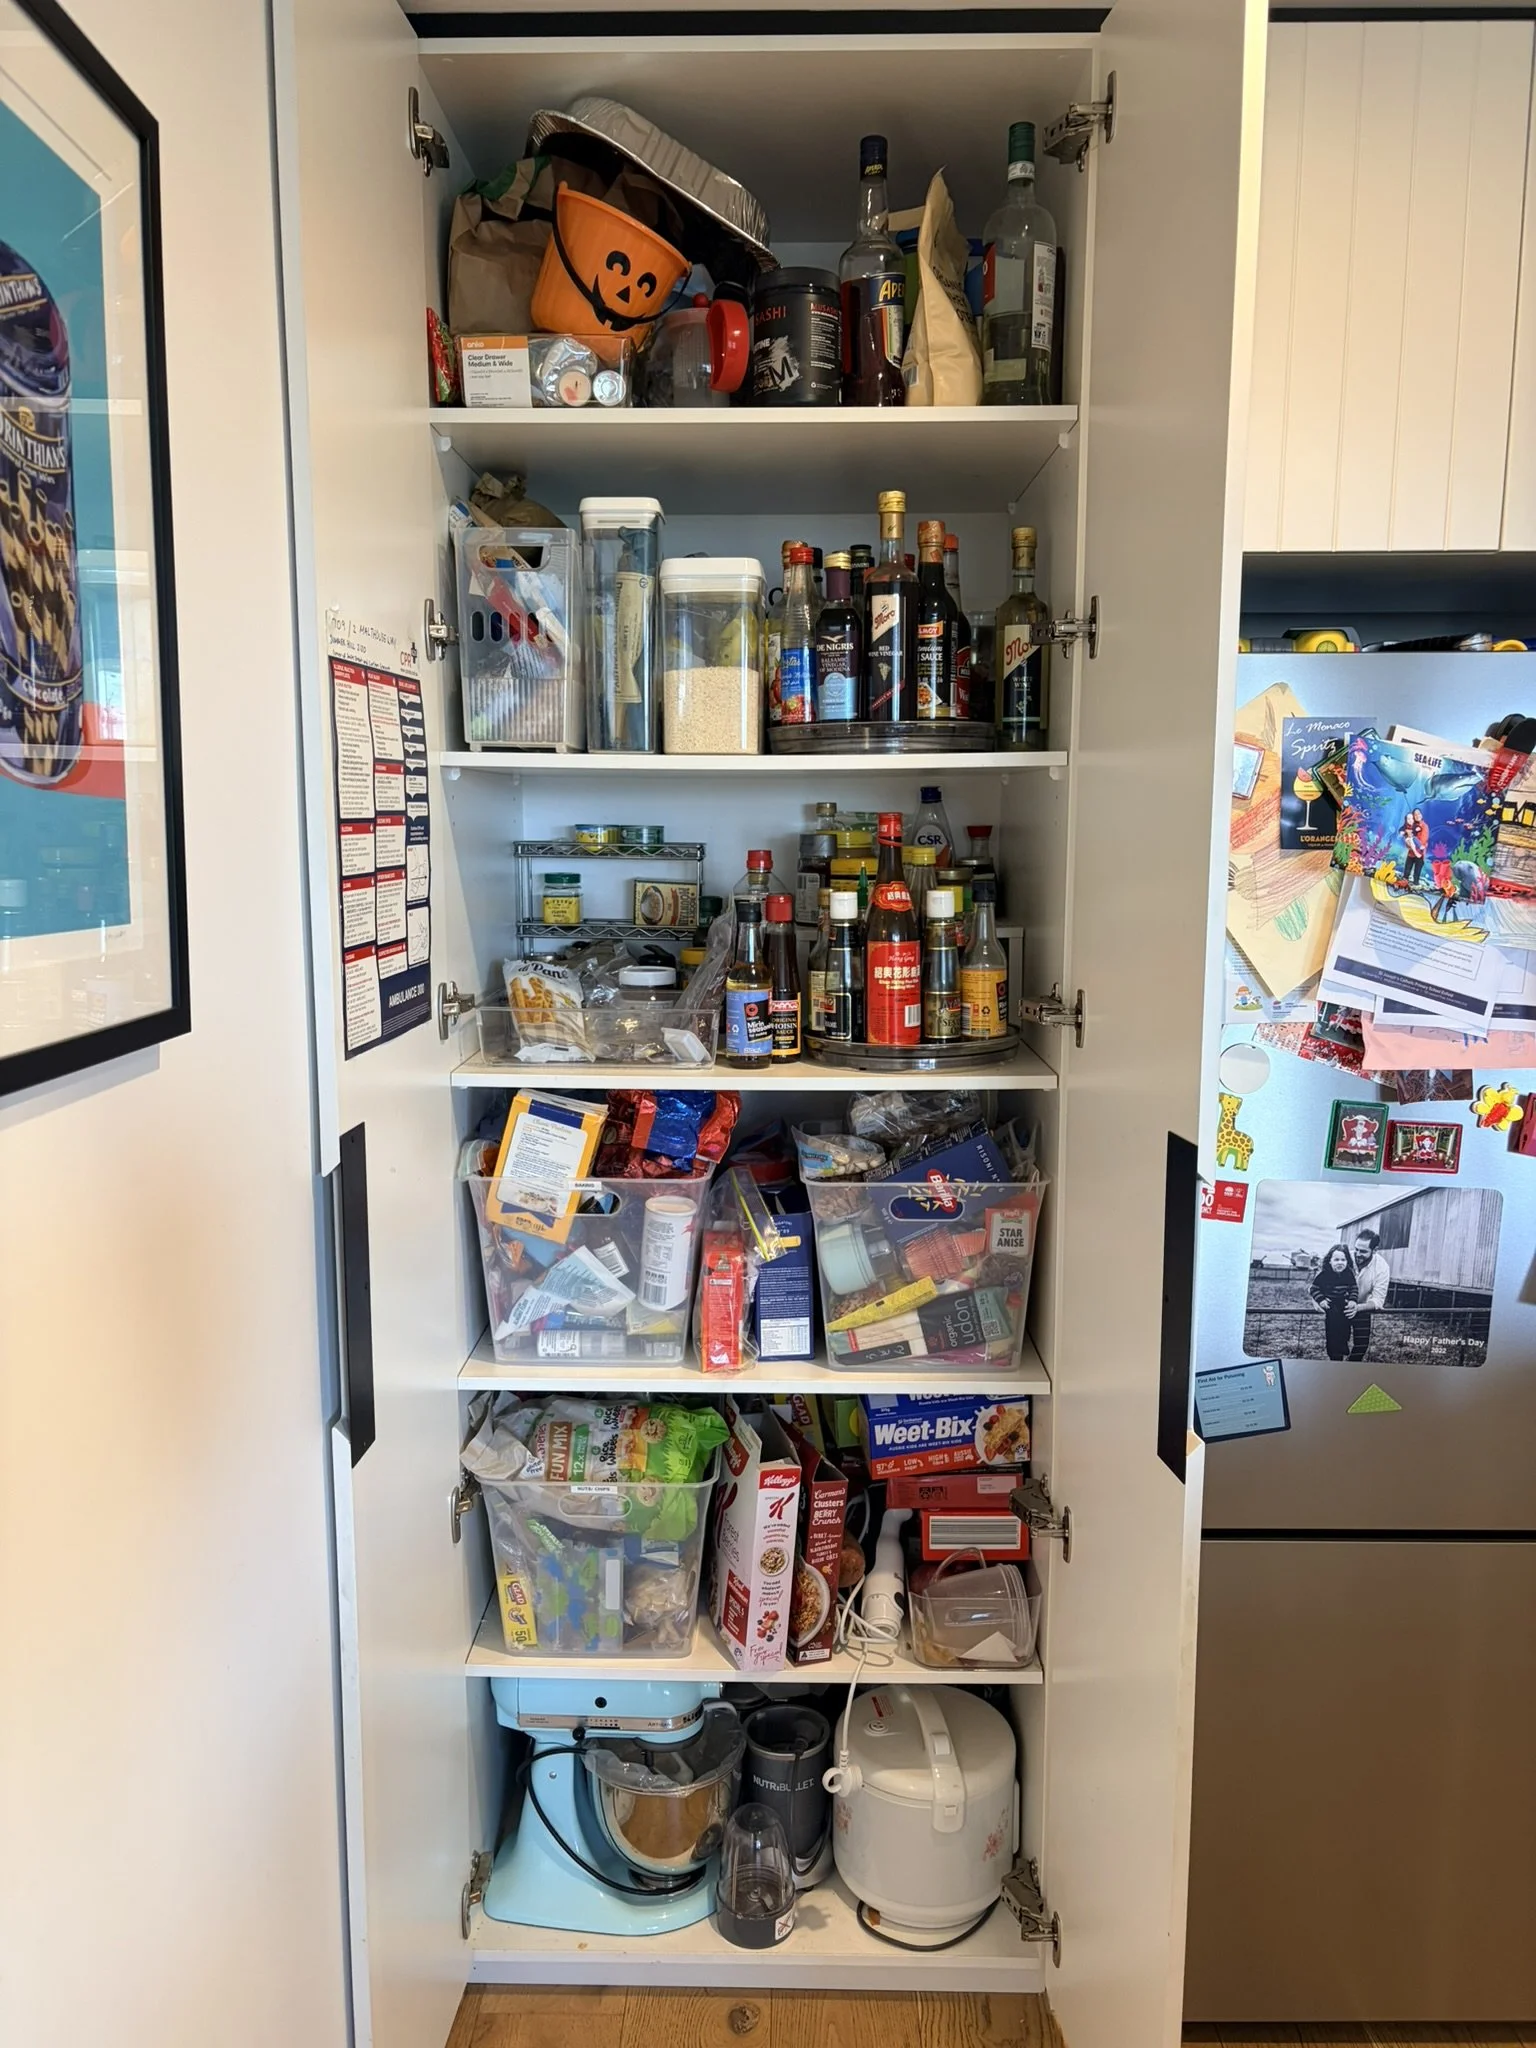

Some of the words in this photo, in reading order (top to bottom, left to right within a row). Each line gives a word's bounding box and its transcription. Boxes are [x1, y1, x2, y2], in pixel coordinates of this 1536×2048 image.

[874, 609, 896, 630] Moro
[826, 643, 854, 651] NIGRIS
[400, 650, 412, 668] CPR
[920, 653, 943, 661] SAUCE
[1285, 723, 1303, 736] Le
[1305, 721, 1351, 733] Monaco
[1291, 737, 1339, 760] Spritz
[917, 835, 942, 845] CSR
[531, 963, 568, 979] Pane
[389, 985, 417, 1008] AMBULANCE
[747, 1021, 765, 1030] Mirin
[976, 1144, 995, 1172] RISONI
[929, 1174, 955, 1209] Barilla
[1000, 1228, 1023, 1237] STAR
[997, 1239, 1024, 1247] ANISE
[954, 1298, 976, 1345] udon
[943, 1314, 958, 1347] organic
[1403, 1335, 1431, 1346] Happy
[1432, 1336, 1466, 1346] Father's
[1467, 1338, 1485, 1348] Day
[551, 1425, 568, 1449] MIX
[874, 1416, 973, 1445] Weet-Bix
[599, 1441, 609, 1463] Rice
[607, 1433, 619, 1466] Wheels
[928, 1454, 943, 1462] HIGH
[550, 1450, 567, 1481] FUN
[763, 1475, 797, 1487] Kellogg's
[814, 1488, 846, 1500] Carman's
[769, 1492, 795, 1520] K
[813, 1509, 838, 1518] BERRY
[812, 1518, 842, 1526] Crunch
[511, 1582, 526, 1605] GLAD
[515, 1630, 527, 1642] 50
